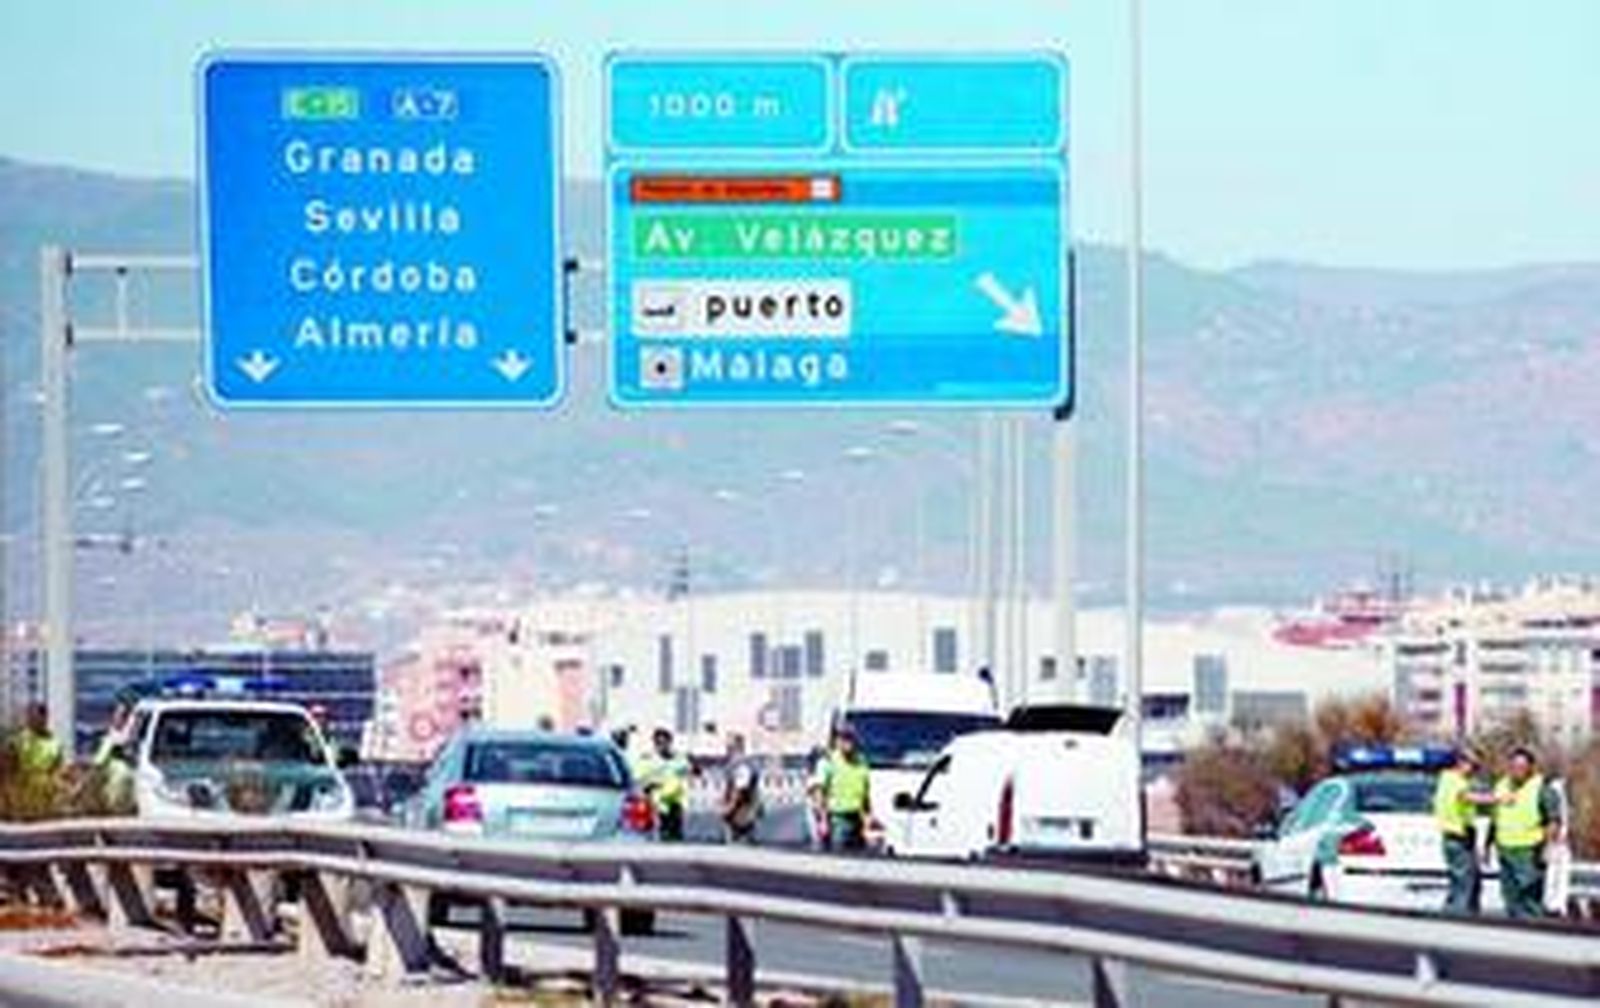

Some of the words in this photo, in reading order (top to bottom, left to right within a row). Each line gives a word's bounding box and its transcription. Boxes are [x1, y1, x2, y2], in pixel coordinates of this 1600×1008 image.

[650, 94, 735, 117] 1000
[753, 96, 780, 117] m
[285, 139, 475, 174] Granada
[305, 200, 461, 233] Sevilla
[290, 257, 477, 292] Córdoba
[705, 293, 845, 323] puerto
